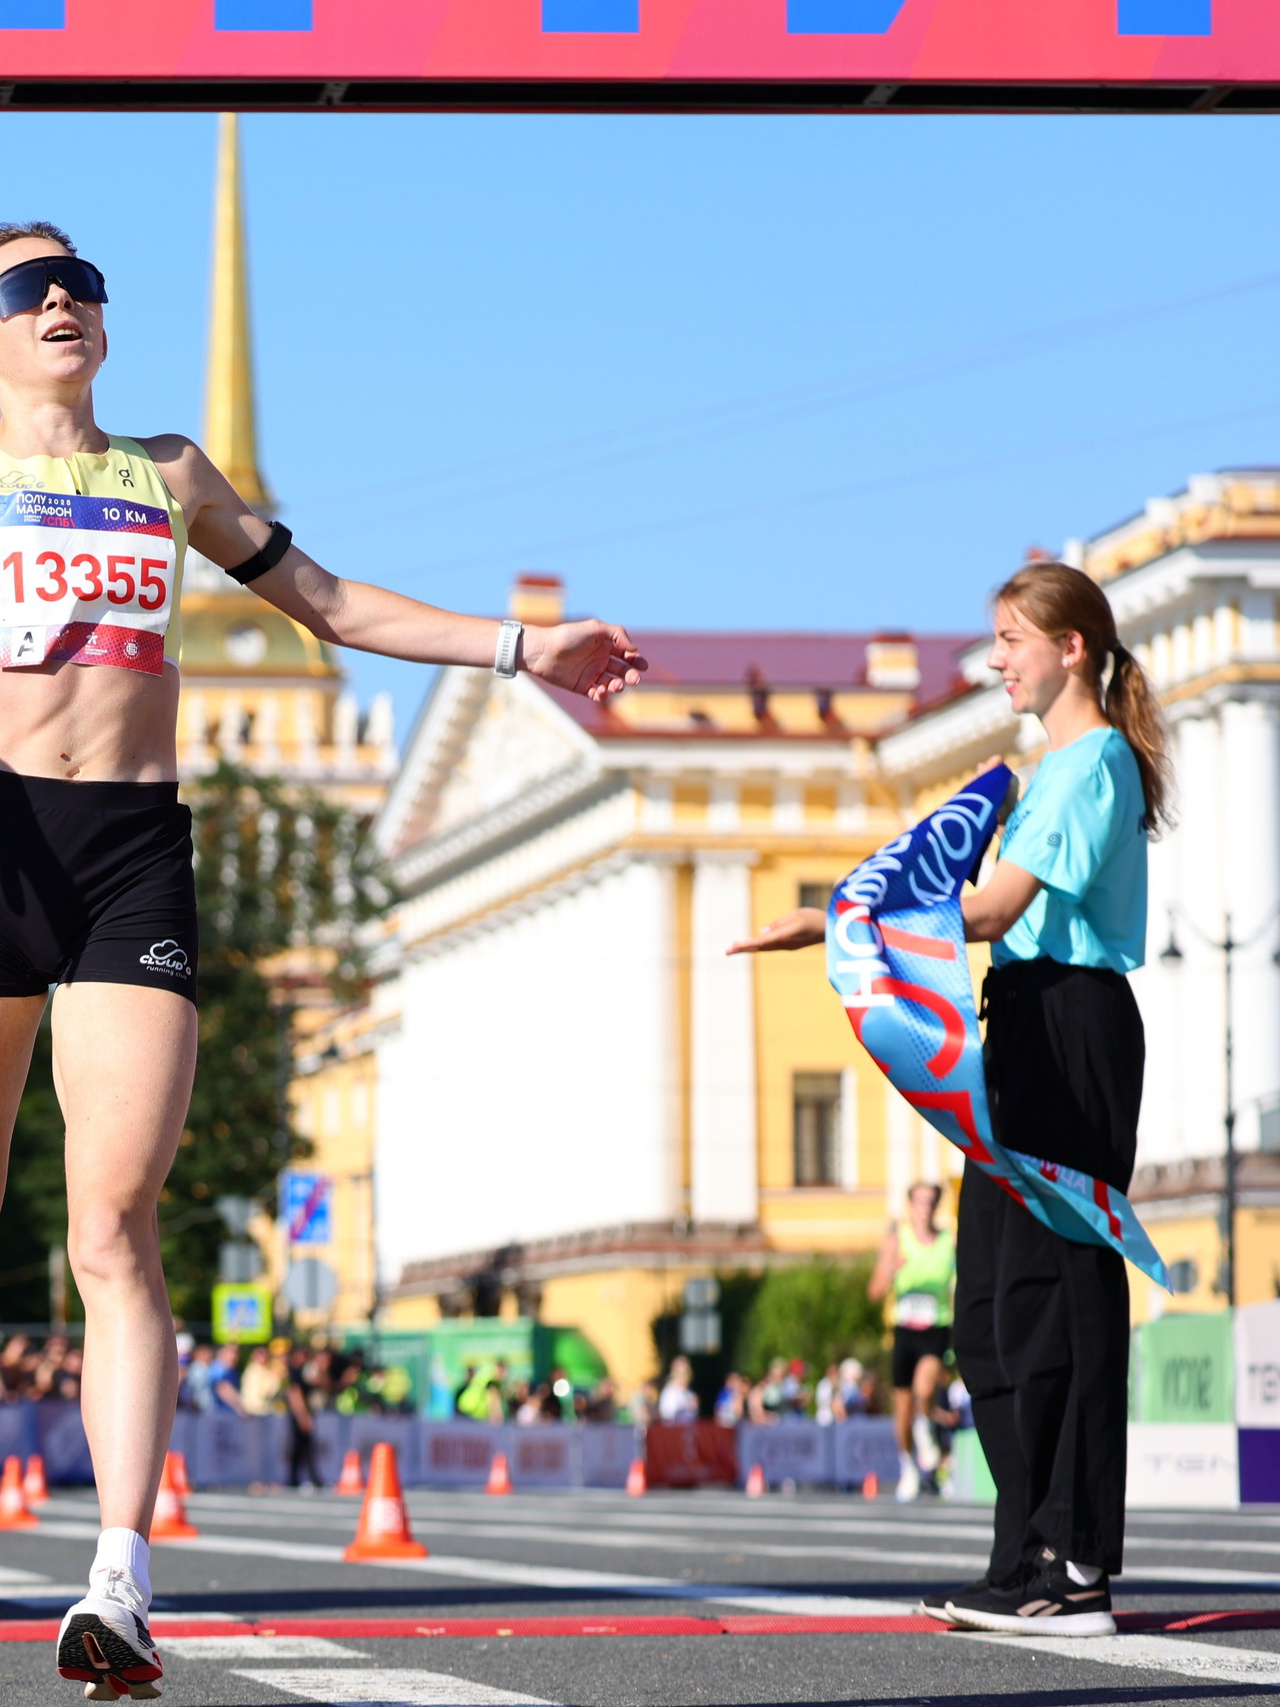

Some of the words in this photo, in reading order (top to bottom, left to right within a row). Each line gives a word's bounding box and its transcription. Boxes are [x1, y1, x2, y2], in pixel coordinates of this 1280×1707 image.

[16, 493, 47, 505] ПОЛУ
[47, 497, 71, 506] 2025
[16, 503, 72, 518] МАРАФОН
[102, 506, 121, 521] 10
[2, 550, 168, 612] 13355
[139, 954, 184, 971] CLOUD
[146, 965, 174, 976] running
